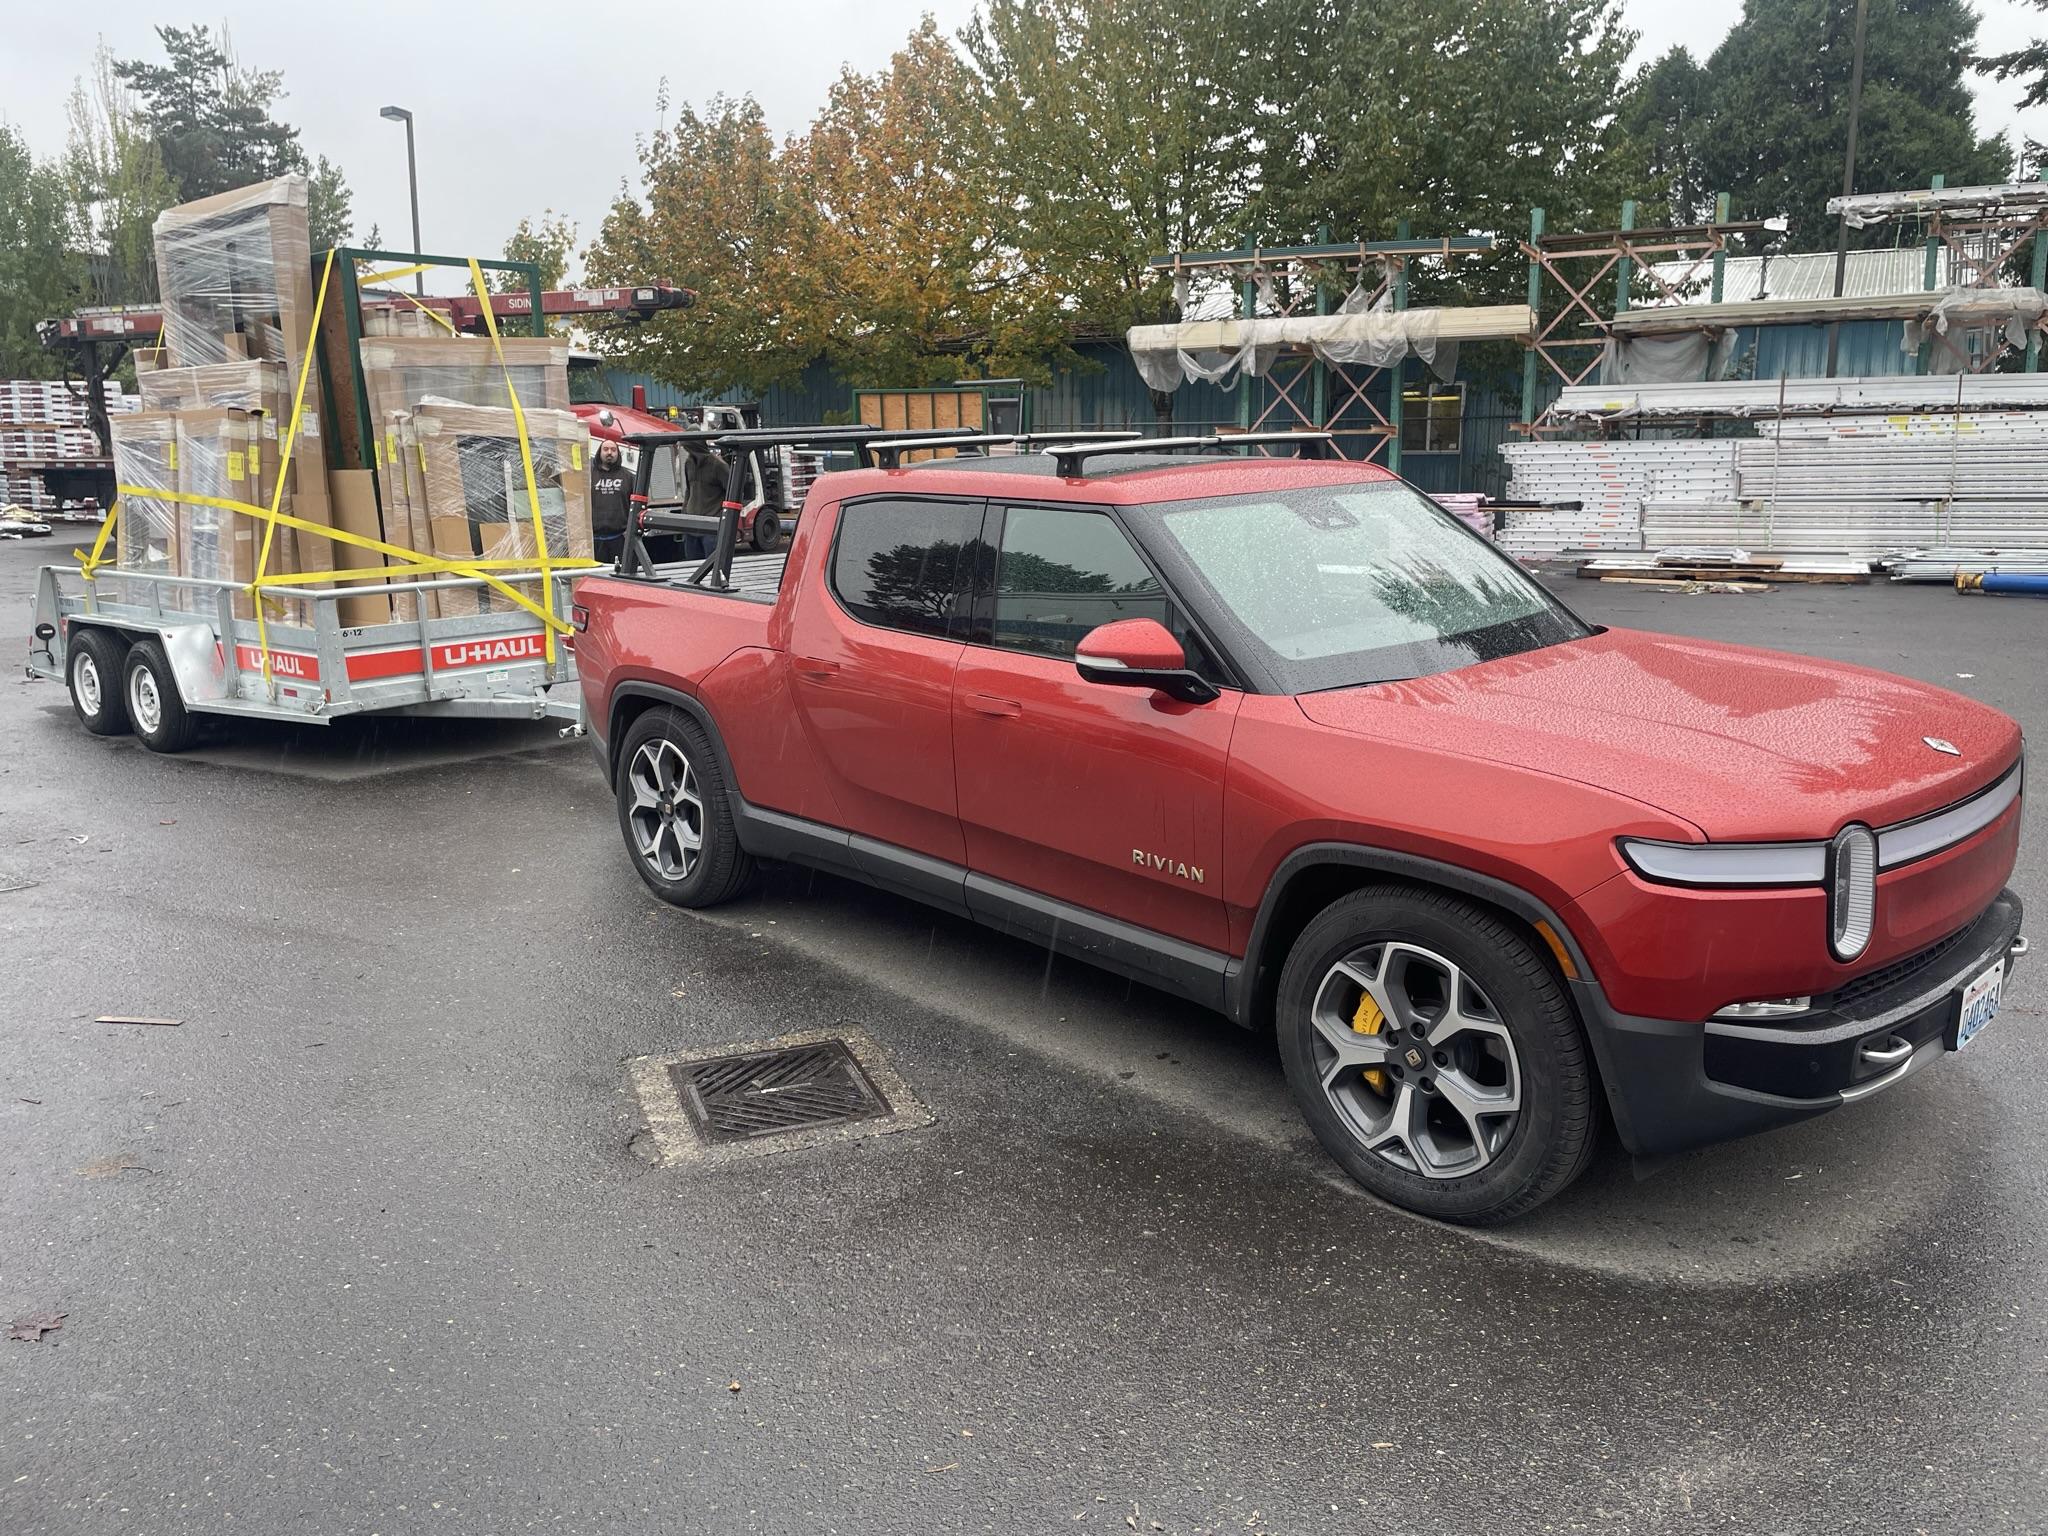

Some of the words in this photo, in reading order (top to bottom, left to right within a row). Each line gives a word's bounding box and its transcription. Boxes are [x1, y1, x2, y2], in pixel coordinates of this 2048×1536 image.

[508, 297, 531, 309] SIDIN
[594, 478, 623, 488] ABC
[250, 650, 304, 675] UHAUL
[444, 638, 541, 665] U-HAUL
[1132, 848, 1204, 884] RIVIAN
